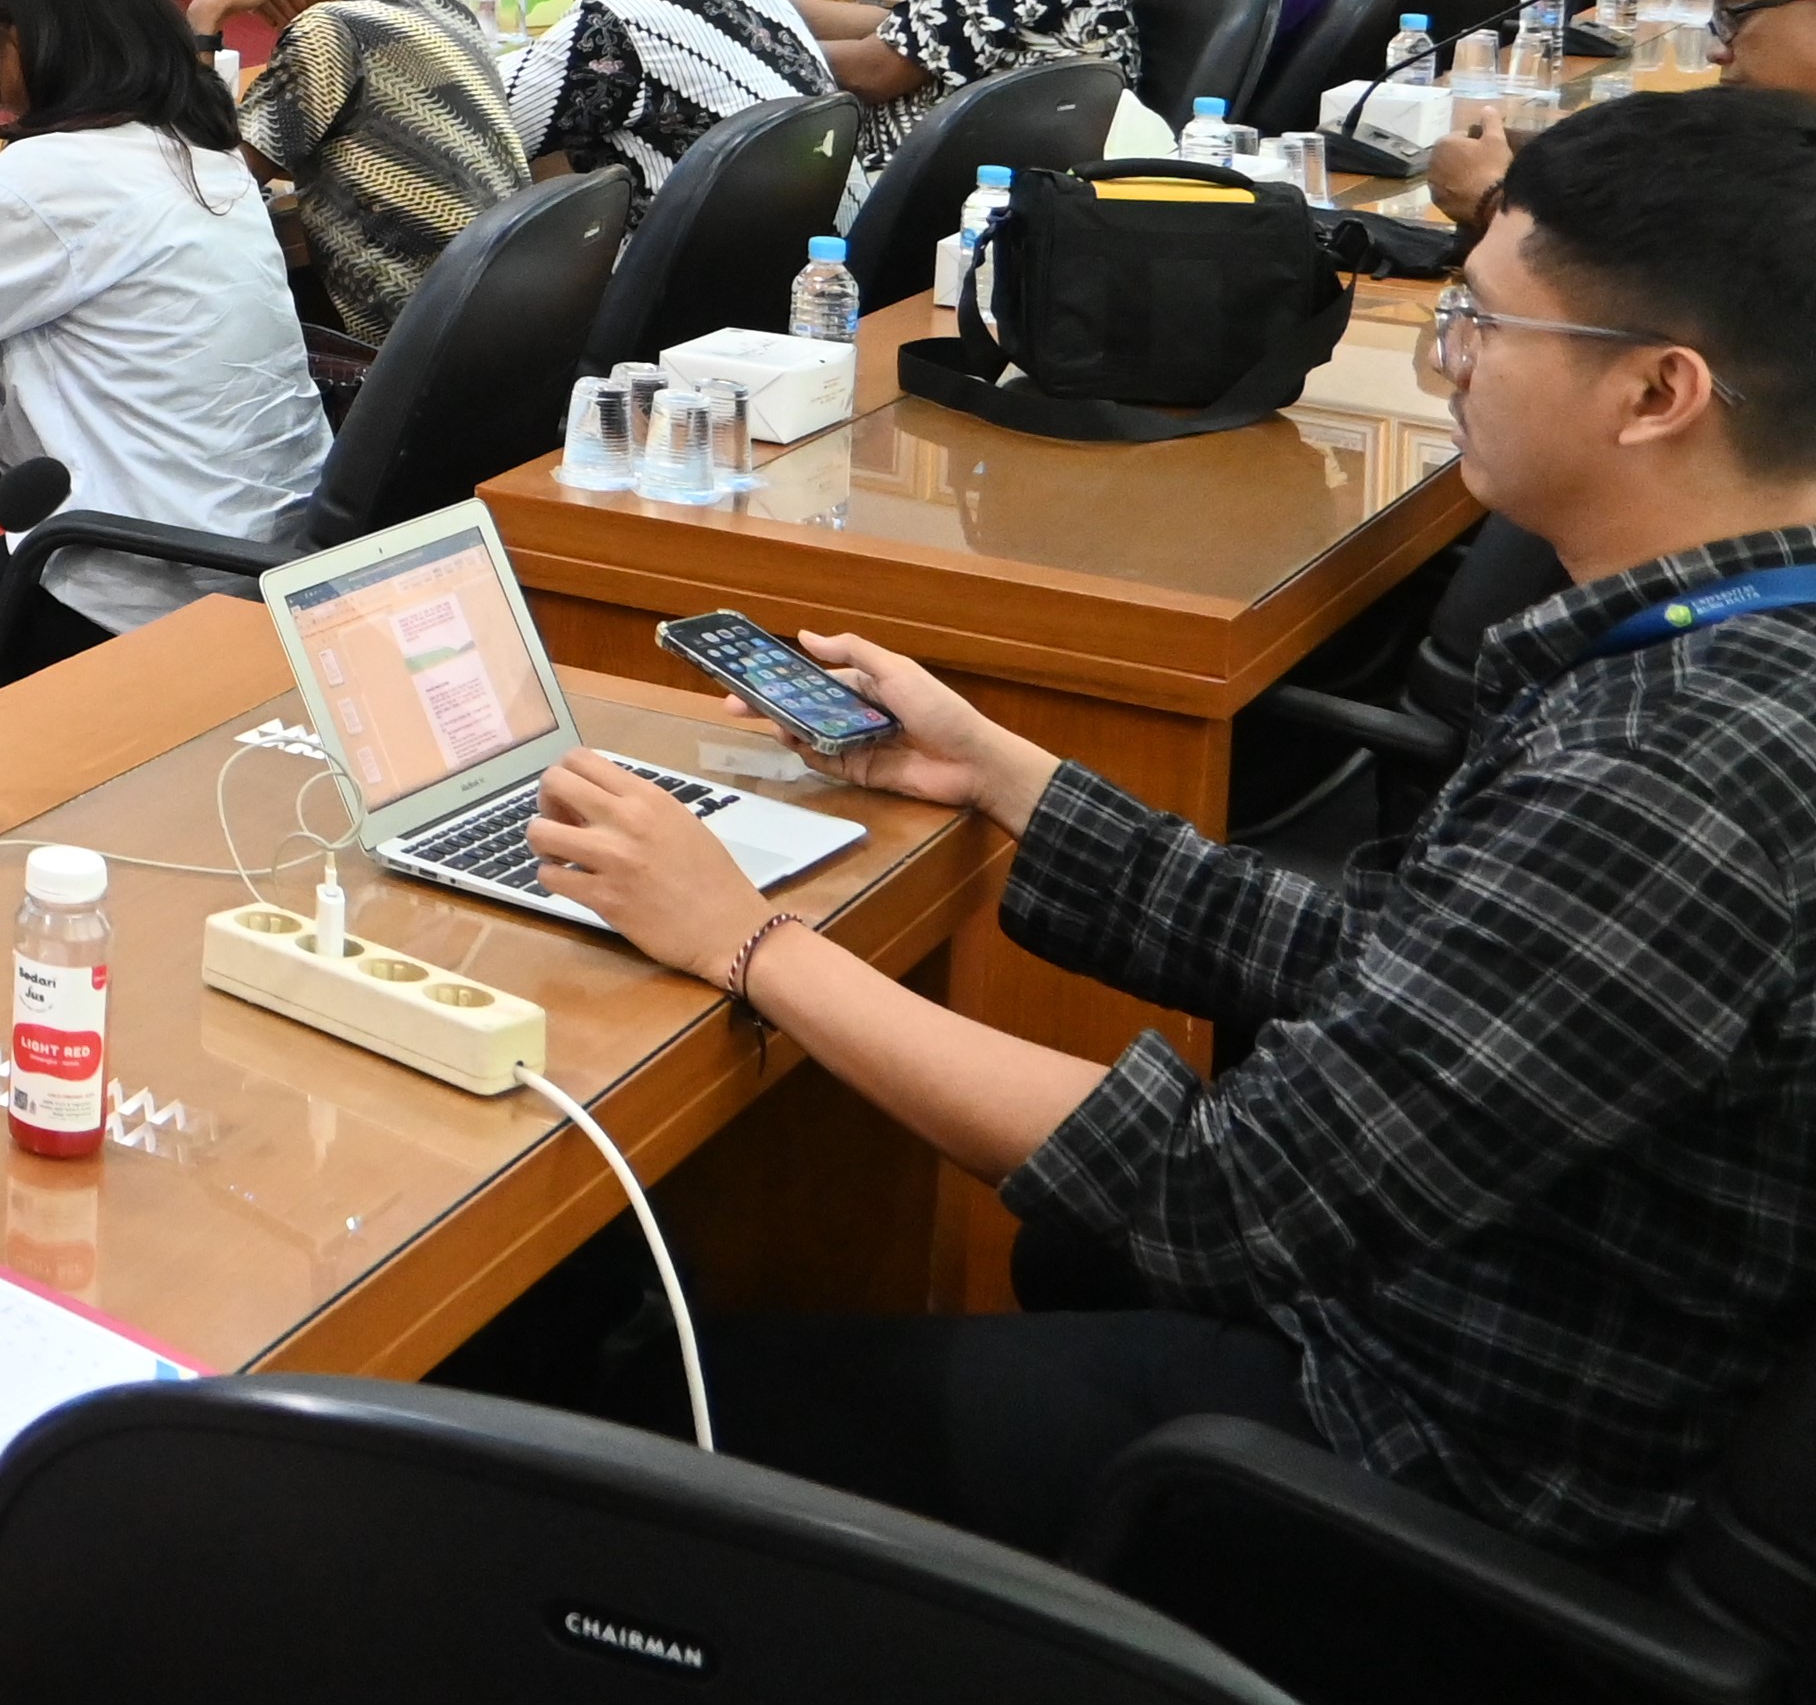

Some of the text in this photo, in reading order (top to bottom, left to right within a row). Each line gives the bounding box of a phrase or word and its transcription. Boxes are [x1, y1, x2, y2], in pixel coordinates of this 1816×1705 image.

[18, 966, 57, 989] Sedari
[24, 985, 46, 1003] Jus
[20, 1036, 91, 1059] LIGHT RED
[564, 1611, 703, 1669] CHAIRMAN
